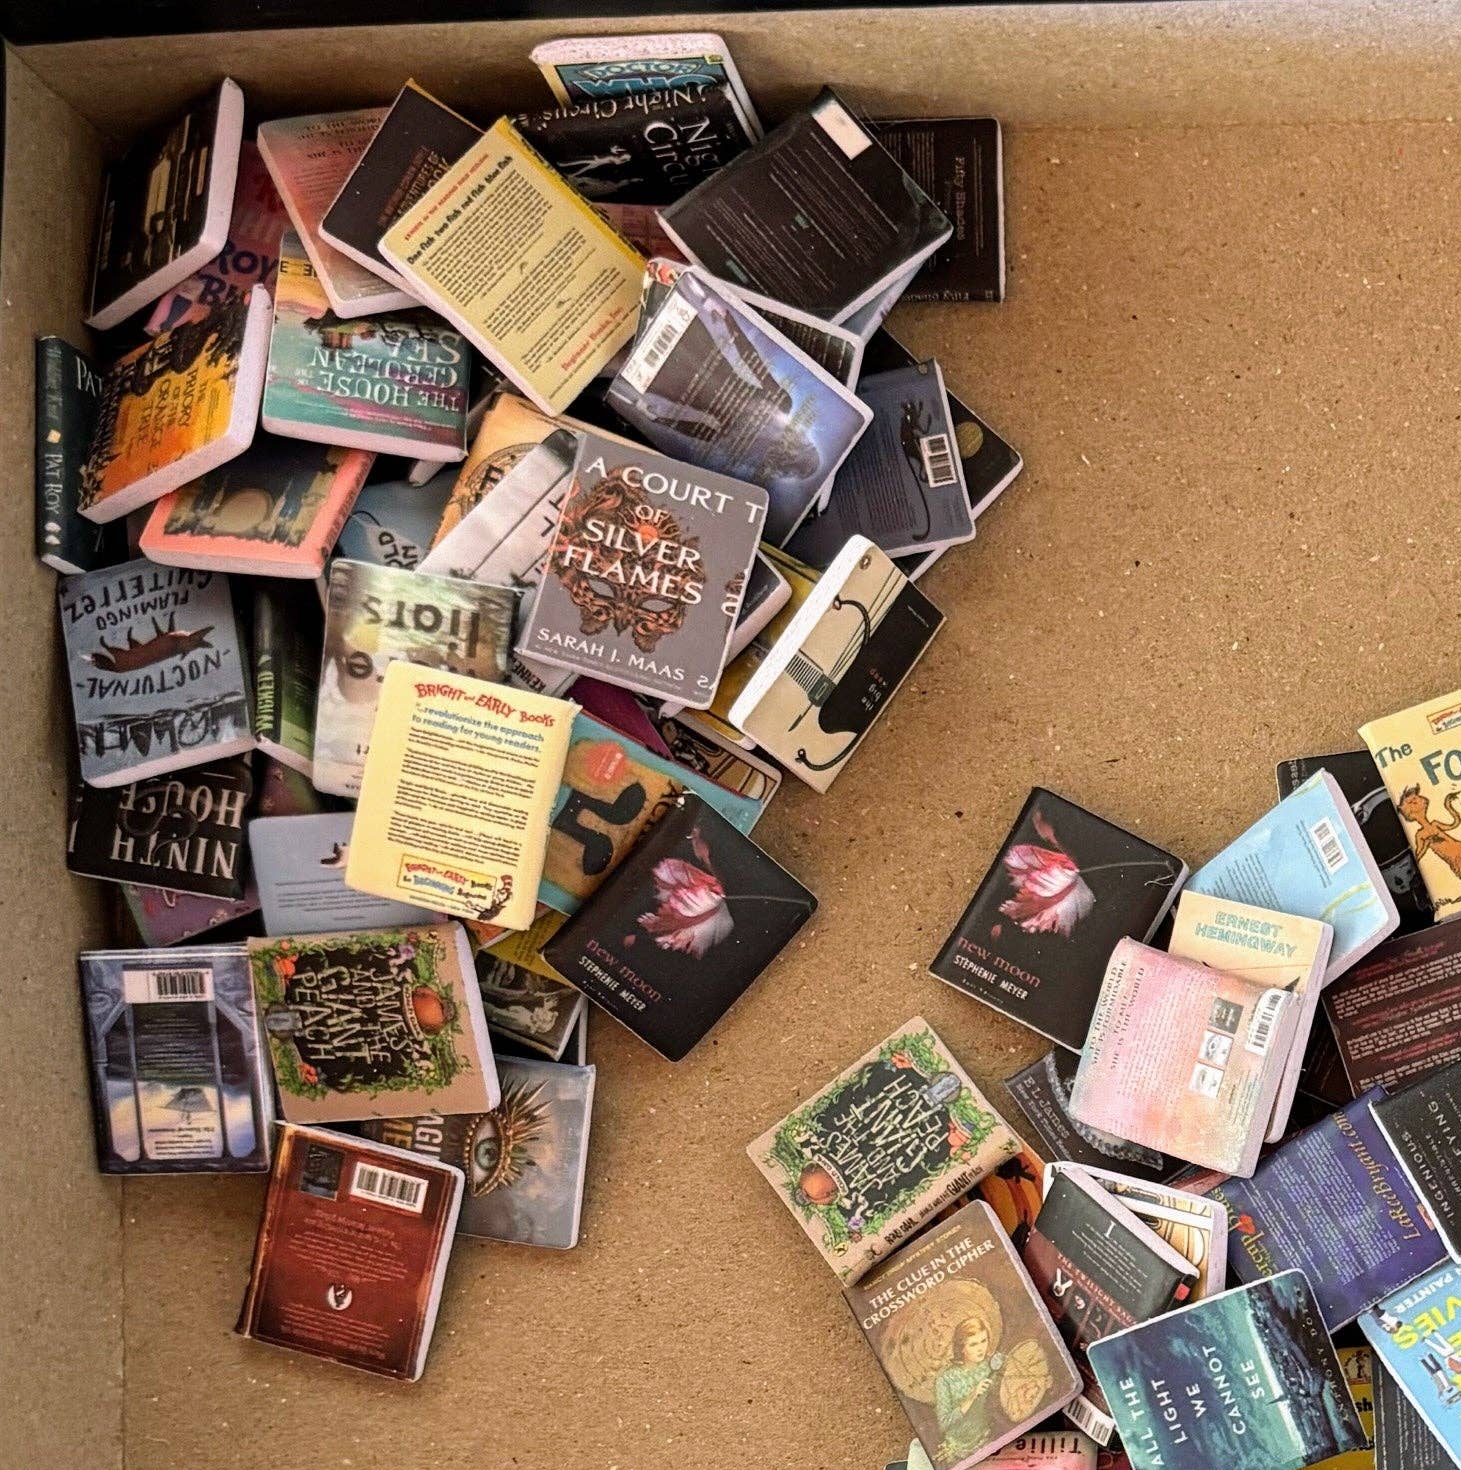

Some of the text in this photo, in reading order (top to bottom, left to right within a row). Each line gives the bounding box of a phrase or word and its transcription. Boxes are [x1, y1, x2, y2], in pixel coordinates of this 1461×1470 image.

[317, 371, 409, 406] HOUSE
[418, 391, 460, 412] THE
[44, 483, 64, 514] ROY
[585, 456, 733, 516] A COURT
[634, 503, 668, 524] OF
[583, 517, 702, 572] SILVER
[561, 543, 705, 606] FLAMES
[95, 586, 191, 631] FLAMINGO
[536, 627, 603, 659] SARAH
[627, 653, 686, 682] MAAS
[414, 683, 465, 699] BRIGHT
[475, 694, 516, 718] EARLY
[423, 718, 459, 734] reading
[459, 726, 473, 736] for
[474, 729, 503, 745] young
[1374, 740, 1414, 770] The
[109, 827, 238, 881] NINTH
[1195, 923, 1297, 958] HEMINGWAY
[1215, 911, 1283, 936] ERNEST
[579, 955, 646, 1012] STEPHENIE MEYER
[586, 939, 662, 1002] new moon
[952, 953, 1029, 1001] STEPHENIE MEYER
[957, 934, 1041, 990] new moon
[292, 969, 337, 1060] PEACH
[883, 1074, 949, 1152] PEACH
[862, 1239, 995, 1330] CROSSWORD CIPHER
[869, 1237, 975, 1309] THE CLUE IN THE
[1182, 1383, 1207, 1420] WE
[1201, 1343, 1247, 1436] CANNOT
[1237, 1359, 1267, 1401] SEE
[1118, 1377, 1167, 1469] ALL THE
[1151, 1376, 1191, 1449] LIGHT
